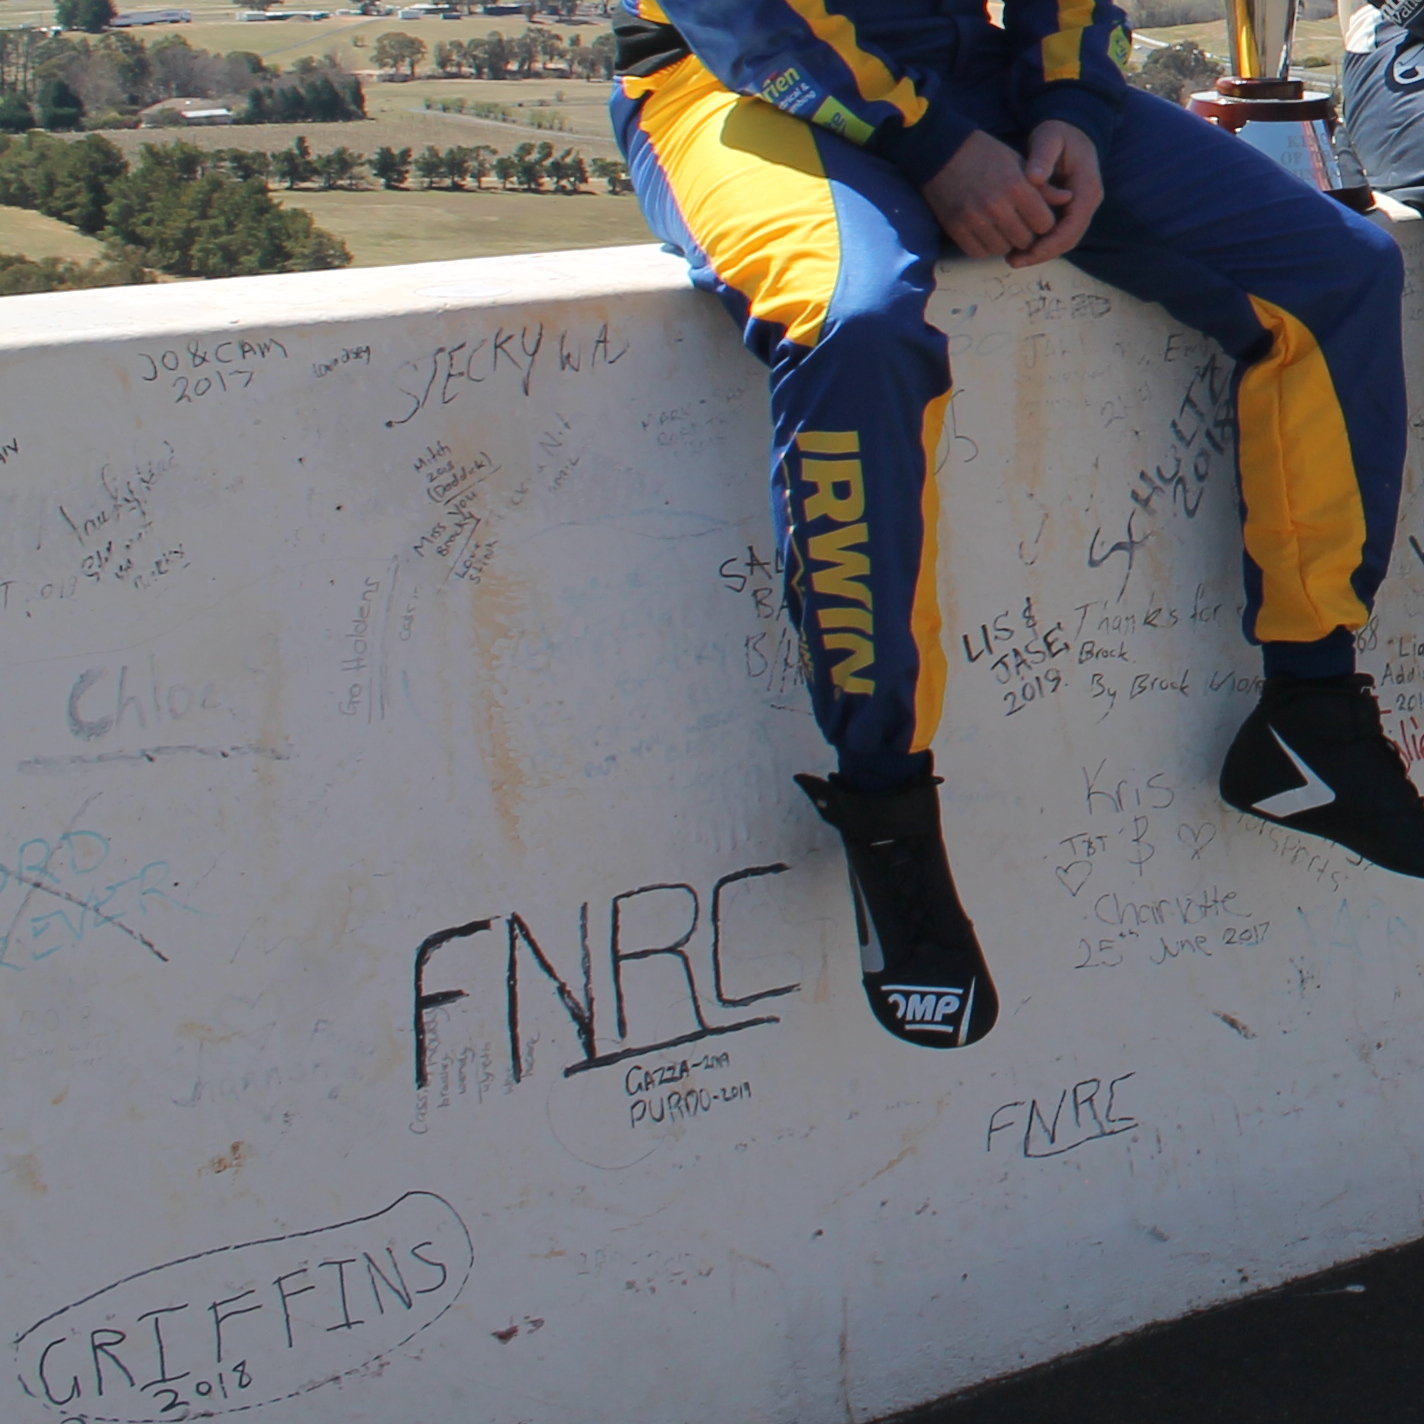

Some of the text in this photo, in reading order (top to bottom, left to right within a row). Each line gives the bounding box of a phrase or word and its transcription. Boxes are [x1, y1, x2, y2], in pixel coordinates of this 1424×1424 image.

[138, 349, 179, 382] JO
[215, 338, 288, 365] CAM
[340, 576, 381, 672] Holdens
[795, 429, 877, 697] IRWIN
[1082, 757, 1175, 816] Kris
[414, 861, 801, 1089] FNRC
[38, 1241, 448, 1406] GRIFFINS
